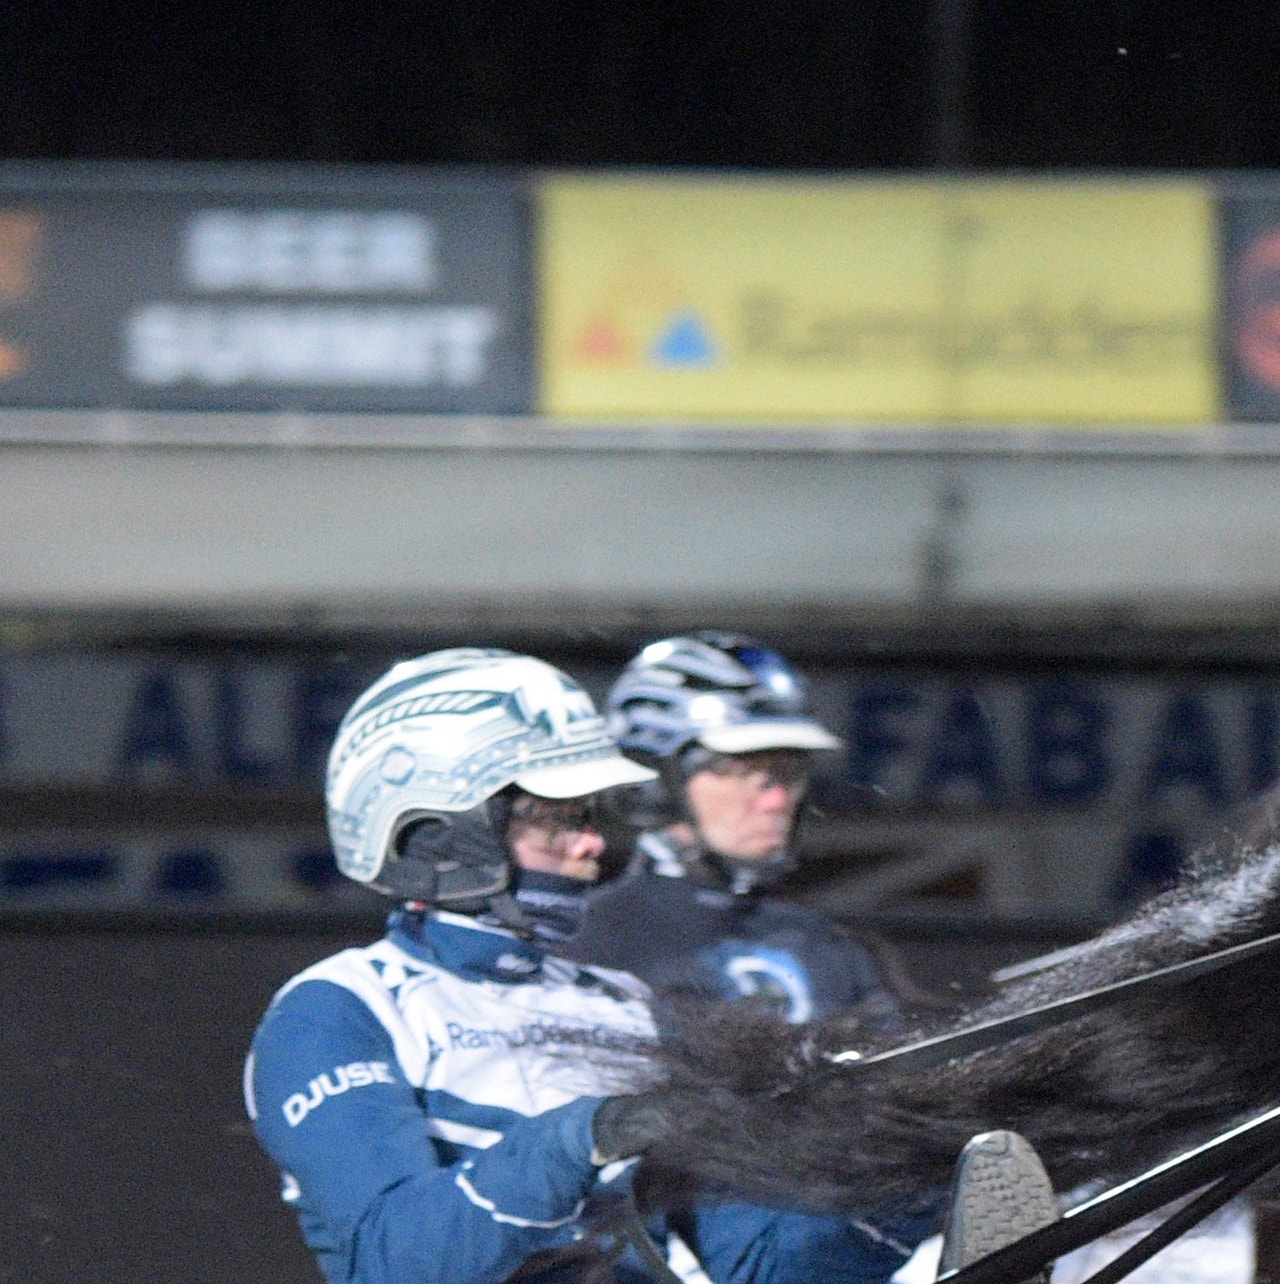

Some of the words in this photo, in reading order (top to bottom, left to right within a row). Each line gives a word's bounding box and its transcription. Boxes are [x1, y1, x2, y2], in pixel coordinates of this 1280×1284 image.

[187, 208, 435, 291] BEER
[127, 302, 496, 385] SUMMIT
[283, 1061, 395, 1127] DJUSE
